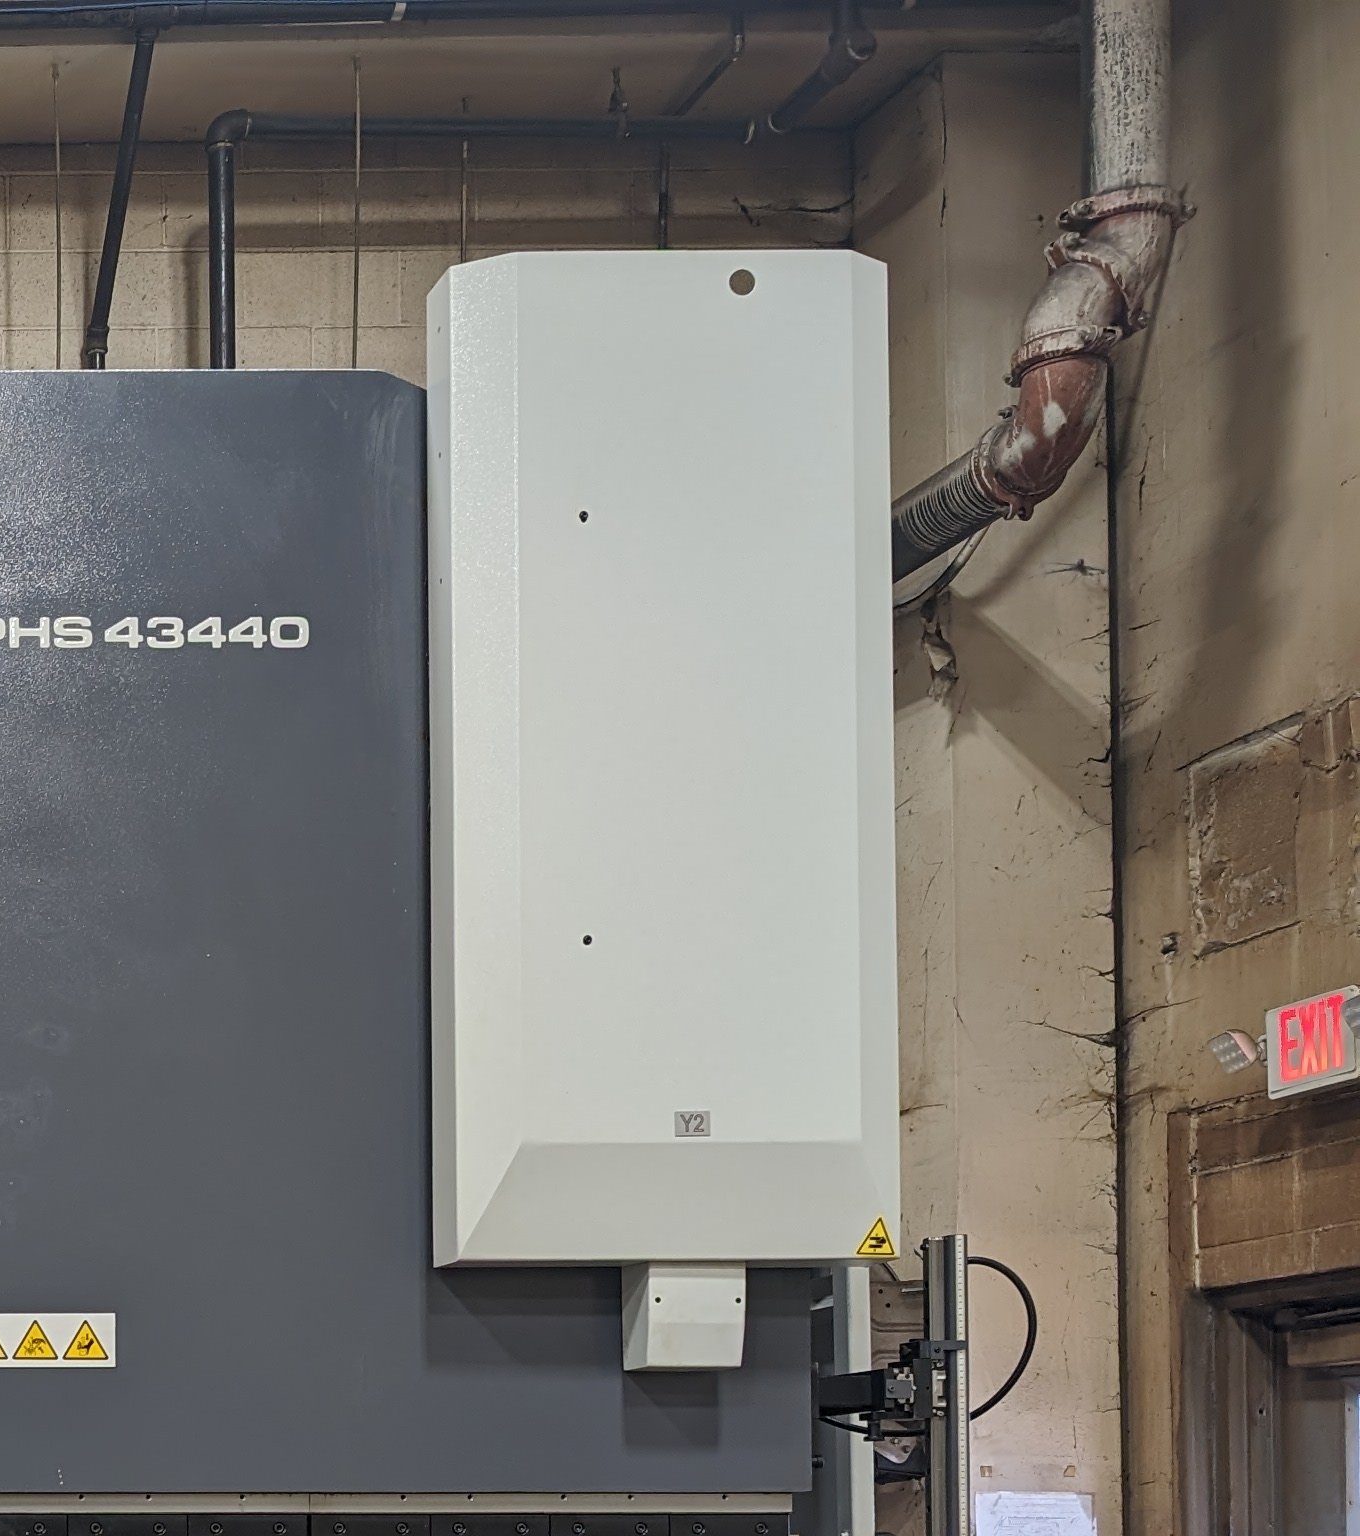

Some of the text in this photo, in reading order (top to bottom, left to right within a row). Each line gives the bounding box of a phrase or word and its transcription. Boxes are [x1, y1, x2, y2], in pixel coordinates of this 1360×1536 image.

[104, 616, 310, 649] 43440
[1279, 994, 1344, 1081] EXIT
[680, 1113, 705, 1133] Y2
